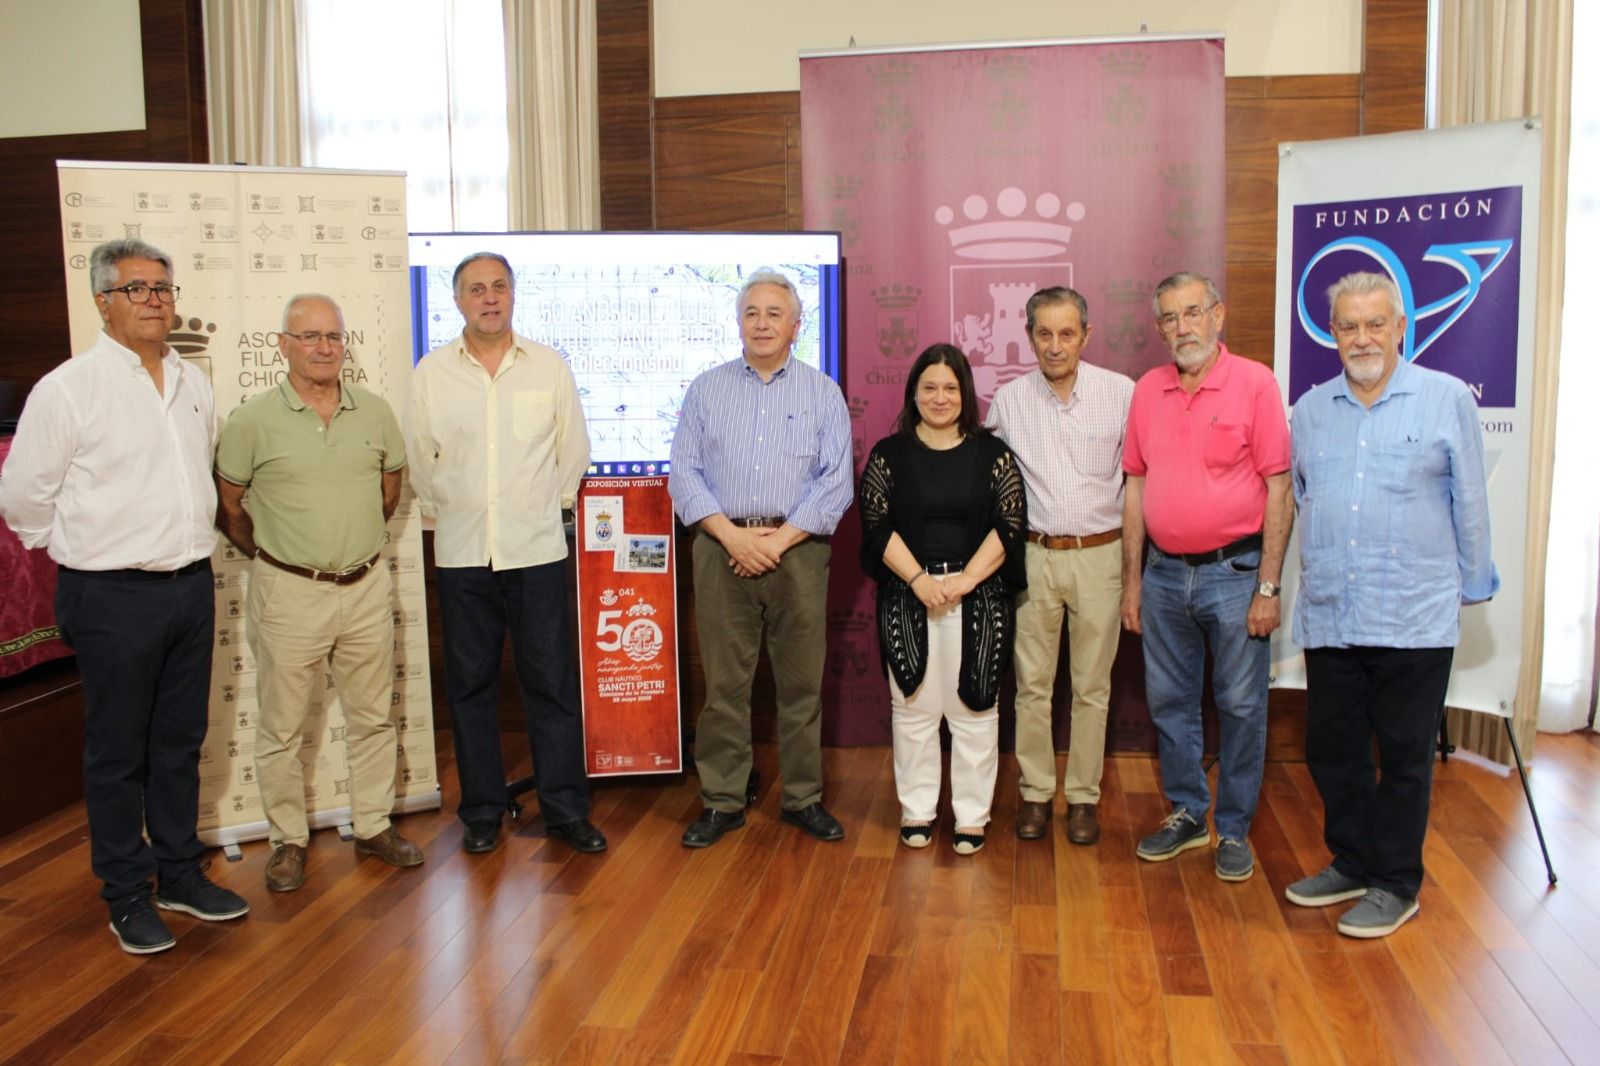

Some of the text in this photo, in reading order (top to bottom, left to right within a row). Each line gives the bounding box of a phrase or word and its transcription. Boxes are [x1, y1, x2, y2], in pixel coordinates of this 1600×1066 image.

[1315, 196, 1493, 228] FUNDACIÓN
[586, 479, 664, 488] EXPOSICIÓN VIRTUAL
[618, 588, 636, 597] 041
[595, 609, 664, 663] 50
[598, 679, 665, 692] SANCTI PETRI
